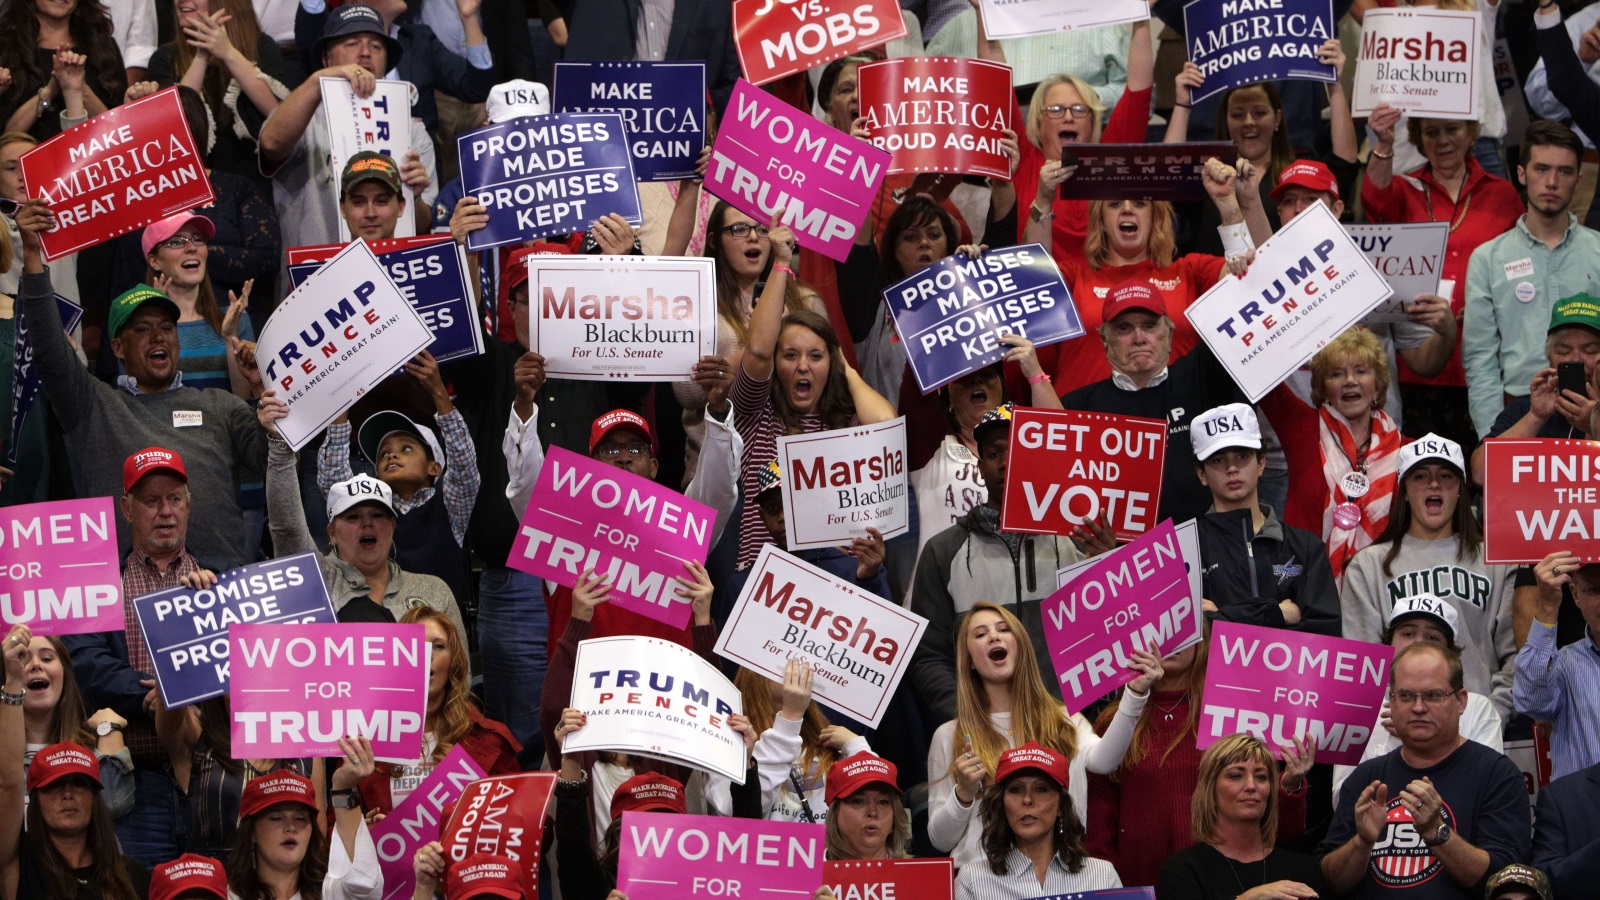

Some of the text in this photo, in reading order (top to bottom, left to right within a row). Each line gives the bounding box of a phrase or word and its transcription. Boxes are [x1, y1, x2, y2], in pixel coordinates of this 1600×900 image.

[1222, 0, 1284, 19] MAKE
[761, 4, 880, 70] MOBS
[1192, 13, 1329, 62] AMERICA
[1361, 30, 1467, 63] Marsha
[1199, 45, 1261, 79] TRONG
[1376, 62, 1468, 84] Blackburn
[504, 89, 540, 106] USA
[591, 82, 653, 100] MAKE
[903, 76, 969, 95] MAKE
[1370, 83, 1438, 97] For U.S. Senate
[350, 93, 359, 118] MAKE
[864, 100, 1007, 132] AMERICA
[68, 124, 134, 163] MAKE
[472, 122, 610, 161] PROMISES
[632, 140, 690, 159] GAIN
[737, 92, 881, 189] WOMEN
[36, 133, 191, 207] AMERICA
[502, 146, 586, 178] MADE
[766, 156, 807, 188] FOR
[45, 193, 116, 234] GREAT
[125, 163, 198, 206] AGAIN
[477, 172, 620, 210] PROMISES
[712, 150, 856, 242] TRUMP
[516, 199, 587, 231] KEPT
[901, 250, 1035, 309] PROMISES
[936, 272, 1018, 316] MADE
[1113, 285, 1152, 297] MAKE AMERICA
[1217, 238, 1335, 339] TRUMP
[543, 286, 694, 321] Marsha
[1115, 293, 1132, 302] GREAT
[1241, 264, 1340, 347] PENCE
[265, 280, 376, 382] TRUMP
[584, 322, 695, 344] Blackburn
[920, 290, 1055, 355] PROMISES
[1241, 346, 1264, 366] MAKE
[1264, 315, 1302, 347] AMERICA
[1301, 293, 1329, 317] GREAT
[1330, 269, 1359, 296] AGAIN!
[280, 308, 380, 392] PENCE
[304, 360, 341, 392] AMERICA
[341, 337, 368, 362] GREAT
[370, 314, 400, 340] AGAIN!
[572, 346, 664, 359] For U.S. Senate
[1315, 340, 1326, 350] 45
[355, 387, 365, 397] 45
[597, 411, 644, 425] MAKE AMERICA
[600, 417, 620, 429] GREAT
[1203, 414, 1244, 437] USA
[1017, 420, 1161, 460] GET OUT
[1413, 440, 1451, 458] USA
[133, 451, 172, 463] Trump
[792, 446, 903, 491] Marsha
[1068, 458, 1120, 482] AND
[346, 480, 385, 498] USA
[553, 460, 708, 546] WOMEN
[837, 481, 904, 509] Blackburn
[1554, 487, 1597, 505] THE
[827, 506, 893, 525] For U.S. Senate
[1022, 481, 1150, 532] VOTE
[593, 522, 640, 552] FOR
[521, 525, 693, 609] TRUMP
[1047, 532, 1177, 631] WOMEN
[153, 565, 304, 622] PROMISES
[1408, 598, 1445, 618] USA
[192, 595, 281, 635] MADE
[752, 571, 899, 666] Marsha
[1103, 602, 1141, 635] FOR
[238, 636, 418, 668] WOMEN
[761, 639, 849, 688] For Senate
[780, 622, 886, 688] Blackburn
[1060, 596, 1192, 699] TRUMP
[1219, 634, 1386, 687] WOMEN
[304, 681, 352, 700] FOR
[589, 669, 733, 716] TRUMP
[1273, 686, 1319, 709] FOR
[234, 708, 422, 744] TRUMP
[599, 692, 722, 729] PENCE
[583, 708, 611, 717] MAKE
[614, 708, 662, 719] AMERICA
[665, 714, 698, 730] GREAT
[701, 727, 733, 747] AGAIN!
[1203, 704, 1370, 753] TRUMP
[46, 749, 92, 762] MAKE AMERICA
[50, 757, 91, 767] GREAT AGAIN
[842, 759, 890, 773] MAKE AMERICA
[847, 765, 889, 777] GREAT AGAIN
[1007, 748, 1056, 762] MAKE AMERICA
[1010, 755, 1053, 766] GREAT AGAIN
[259, 778, 307, 790] MAKE AMERICA
[263, 785, 306, 795] GREAT AGAIN
[630, 783, 678, 794] MAKE AMERICA
[635, 789, 676, 800] GREAT AGAIN
[376, 758, 481, 862] OMEN
[451, 781, 493, 862] PROUD
[771, 802, 790, 816] Life
[630, 825, 817, 870] WOMEN
[165, 861, 216, 876] MAKE AMERICA
[170, 868, 213, 881] GREAT AGAIN
[458, 863, 508, 877] MAKE AMERICA
[463, 871, 506, 883] GREAT AGAIN
[1500, 868, 1532, 877] TRUMP
[692, 876, 742, 897] FOR
[828, 882, 896, 900] MAKE
